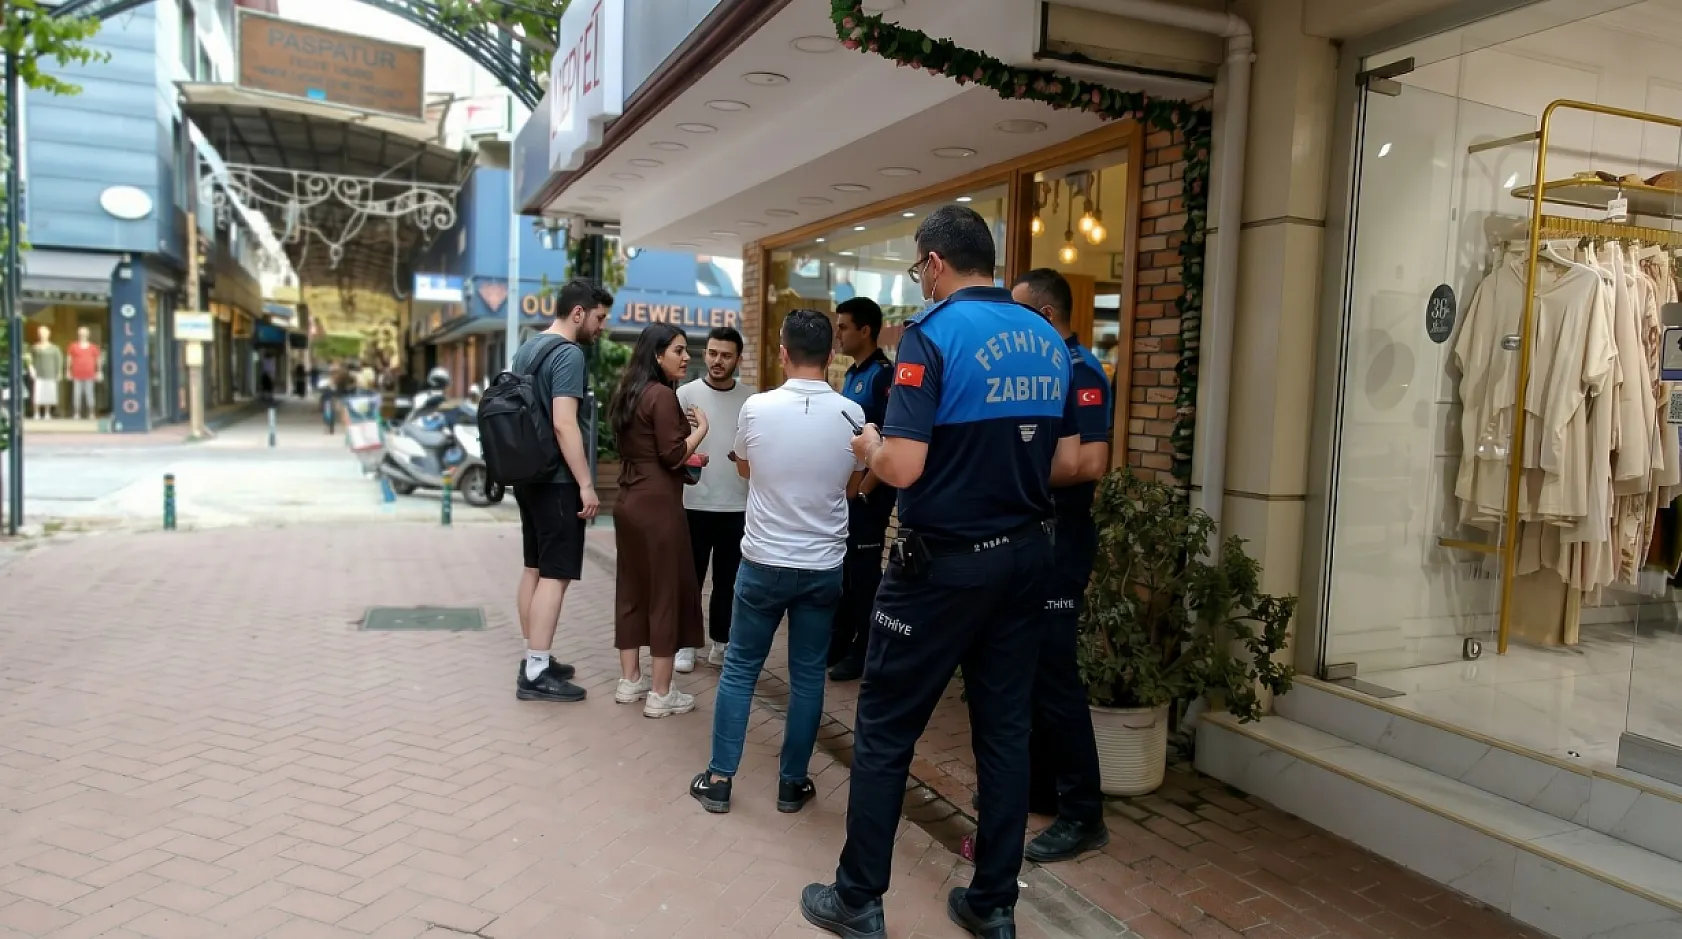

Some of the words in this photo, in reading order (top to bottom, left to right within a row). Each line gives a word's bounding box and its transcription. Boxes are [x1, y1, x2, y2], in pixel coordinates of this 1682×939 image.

[268, 27, 397, 70] PASPATUR
[620, 301, 743, 328] JEWELLER
[974, 329, 1064, 371] FETHİYE
[986, 375, 1062, 403] ZABITA
[1044, 598, 1075, 610] THİYE
